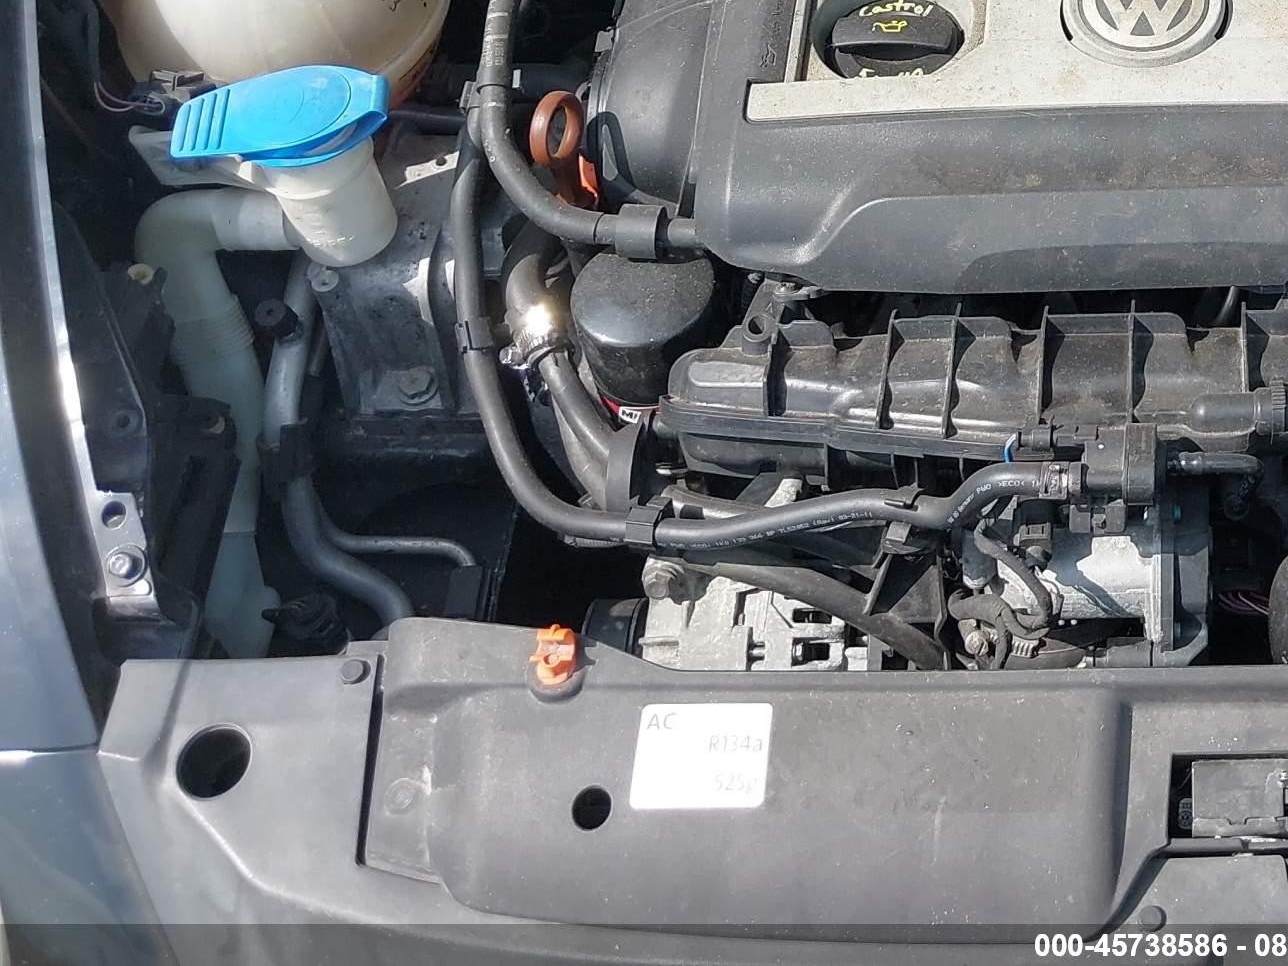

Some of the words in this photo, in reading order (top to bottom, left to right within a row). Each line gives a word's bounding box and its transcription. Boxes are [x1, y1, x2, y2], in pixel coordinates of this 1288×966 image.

[859, 0, 933, 18] Castrol
[646, 712, 677, 731] AC
[708, 734, 763, 754] R134a
